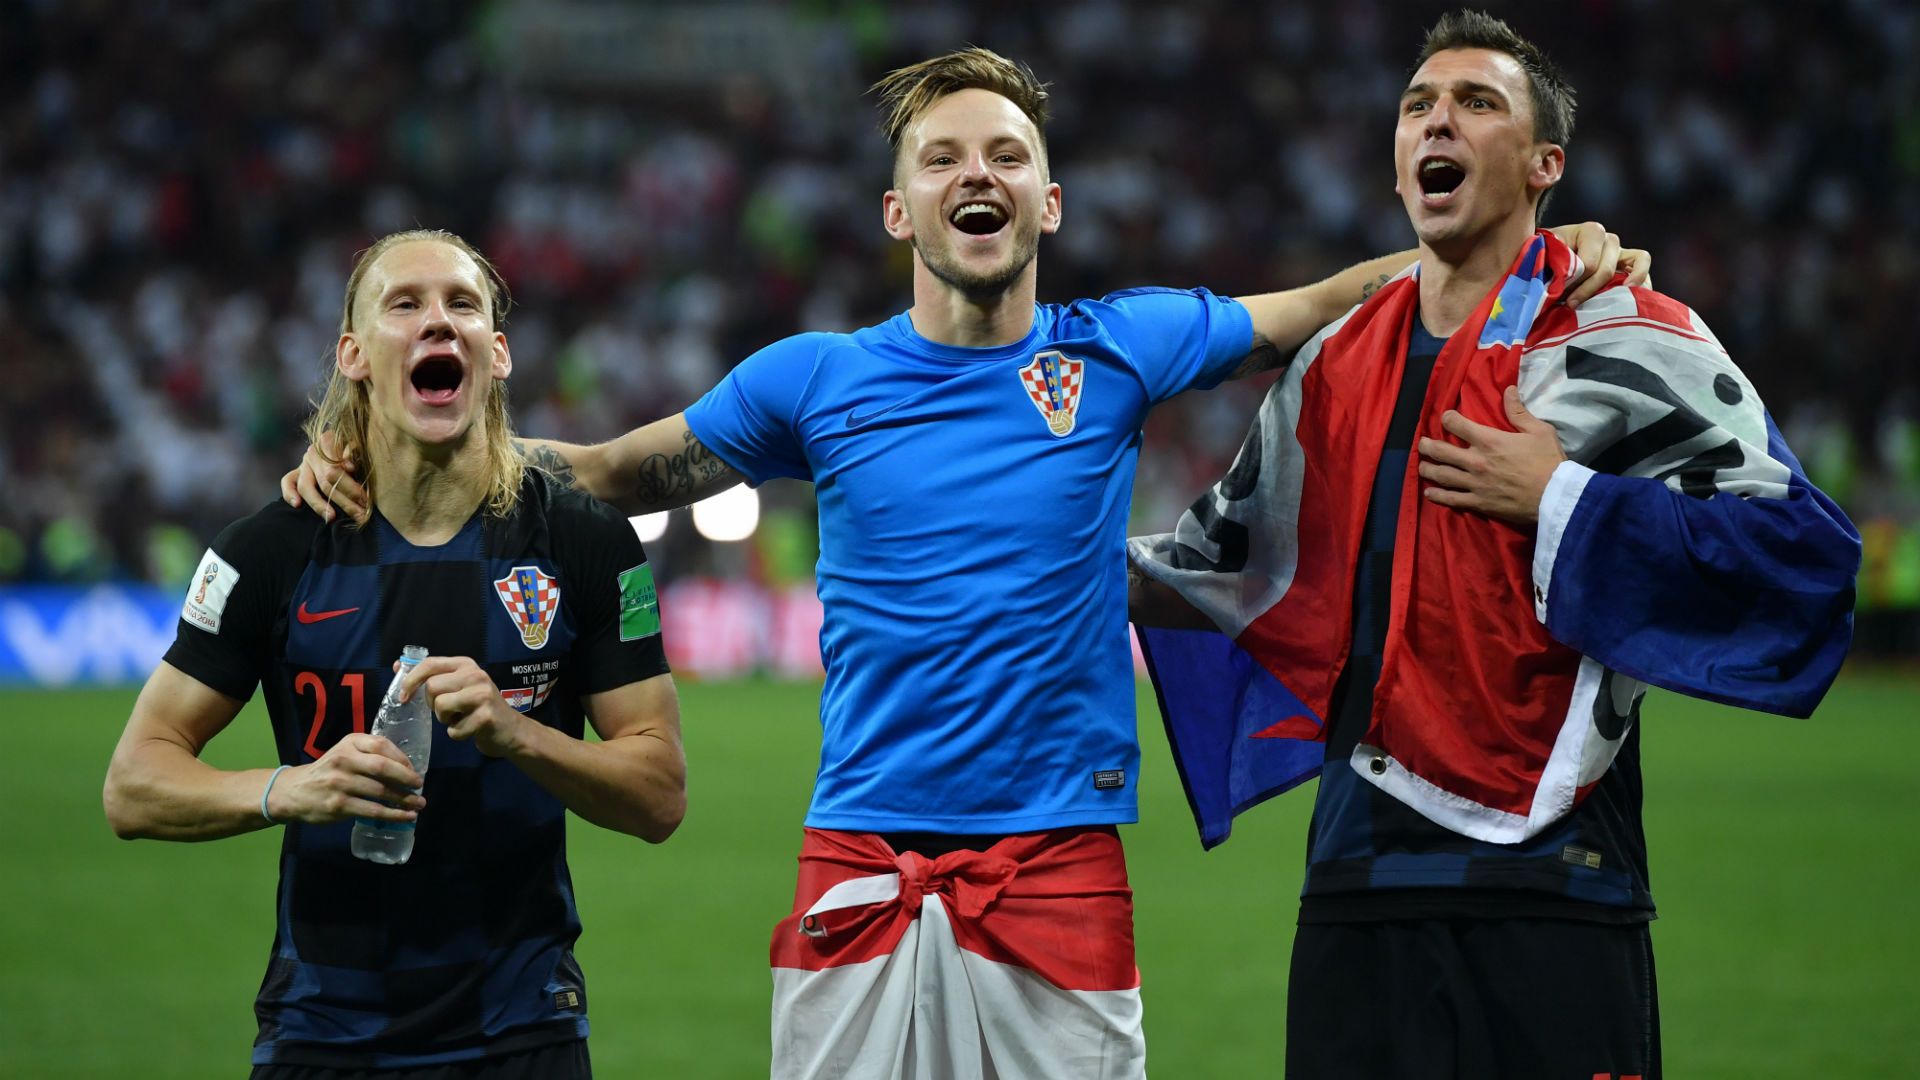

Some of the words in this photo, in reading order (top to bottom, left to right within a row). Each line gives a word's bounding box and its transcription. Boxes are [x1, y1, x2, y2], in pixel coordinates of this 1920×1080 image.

[1045, 361, 1060, 402] HNS
[521, 575, 536, 614] HNS
[512, 664, 541, 674] MOSKVA
[295, 671, 365, 759] 21
